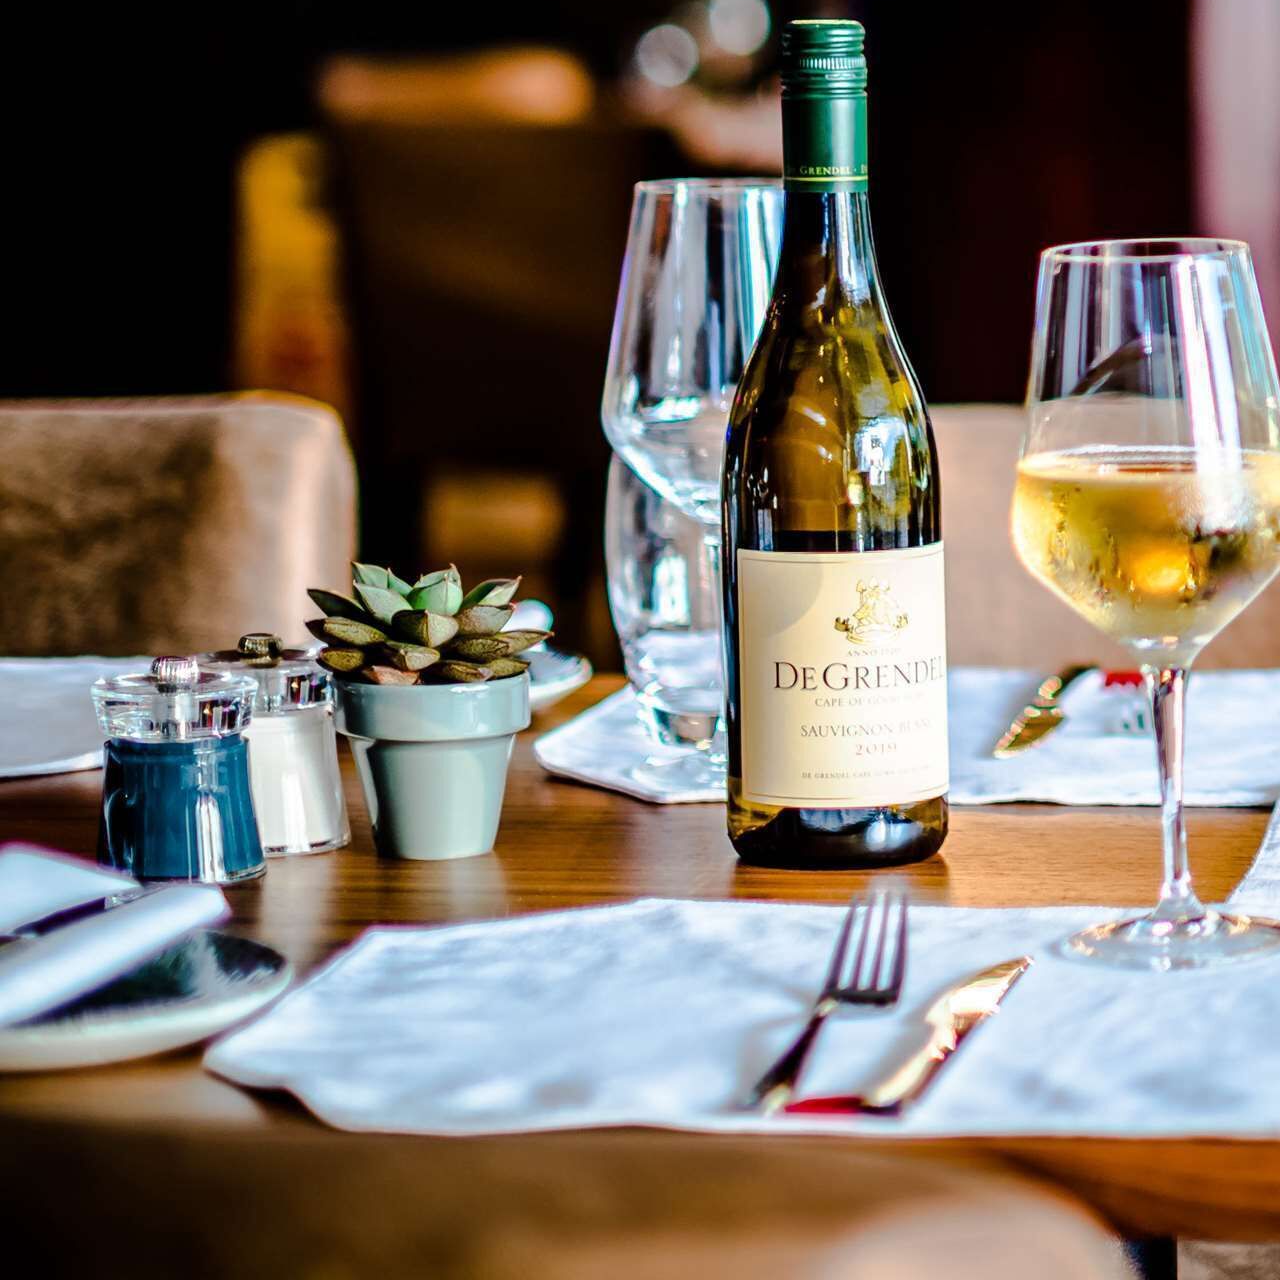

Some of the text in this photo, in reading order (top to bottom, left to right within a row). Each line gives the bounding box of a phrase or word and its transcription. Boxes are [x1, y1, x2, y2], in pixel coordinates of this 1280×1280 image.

[799, 165, 851, 175] GRENDEL
[814, 697, 843, 708] CAPE
[800, 722, 894, 738] SAUVIGNON
[855, 743, 897, 756] 2019
